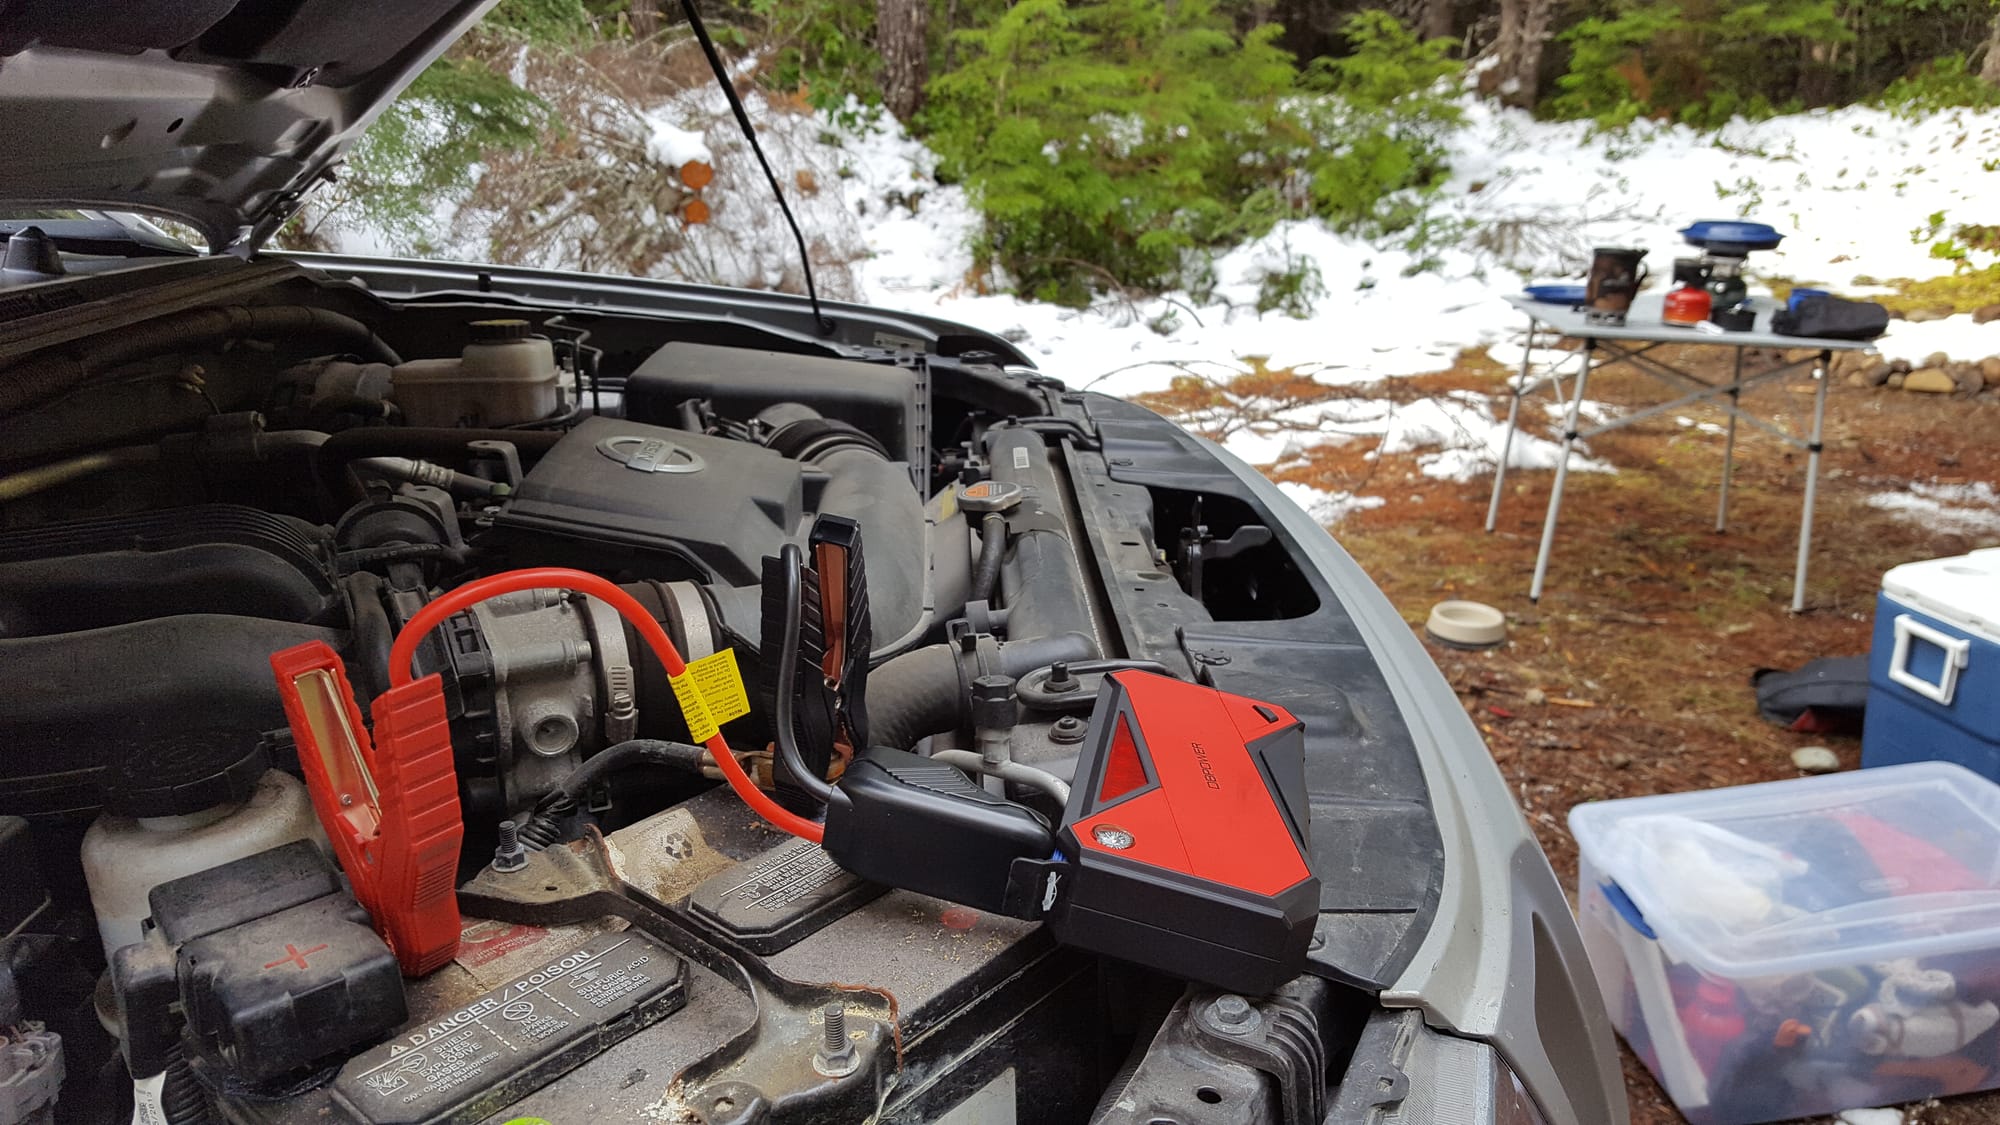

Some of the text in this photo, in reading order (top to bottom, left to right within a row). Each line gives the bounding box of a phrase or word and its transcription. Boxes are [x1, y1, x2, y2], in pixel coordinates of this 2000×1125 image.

[1192, 742, 1219, 790] DBPOWER
[756, 869, 782, 884] FLUSH
[780, 860, 799, 872] EYES
[763, 874, 784, 888] WITH
[577, 955, 649, 996] SULFURIC ACID
[584, 975, 630, 1000] CAN CAUSE
[408, 999, 498, 1046] DANGER
[514, 950, 591, 994] POISON
[520, 1015, 538, 1027] NO
[433, 1030, 473, 1053] SHIELD
[440, 1041, 471, 1060] EYES
[420, 1042, 483, 1077] EXPLOSIVE
[423, 1075, 452, 1093] CAUSE
[452, 1051, 499, 1078] BLINDNESS
[427, 1060, 466, 1082] GASES
[438, 1068, 482, 1093] OR INJURY
